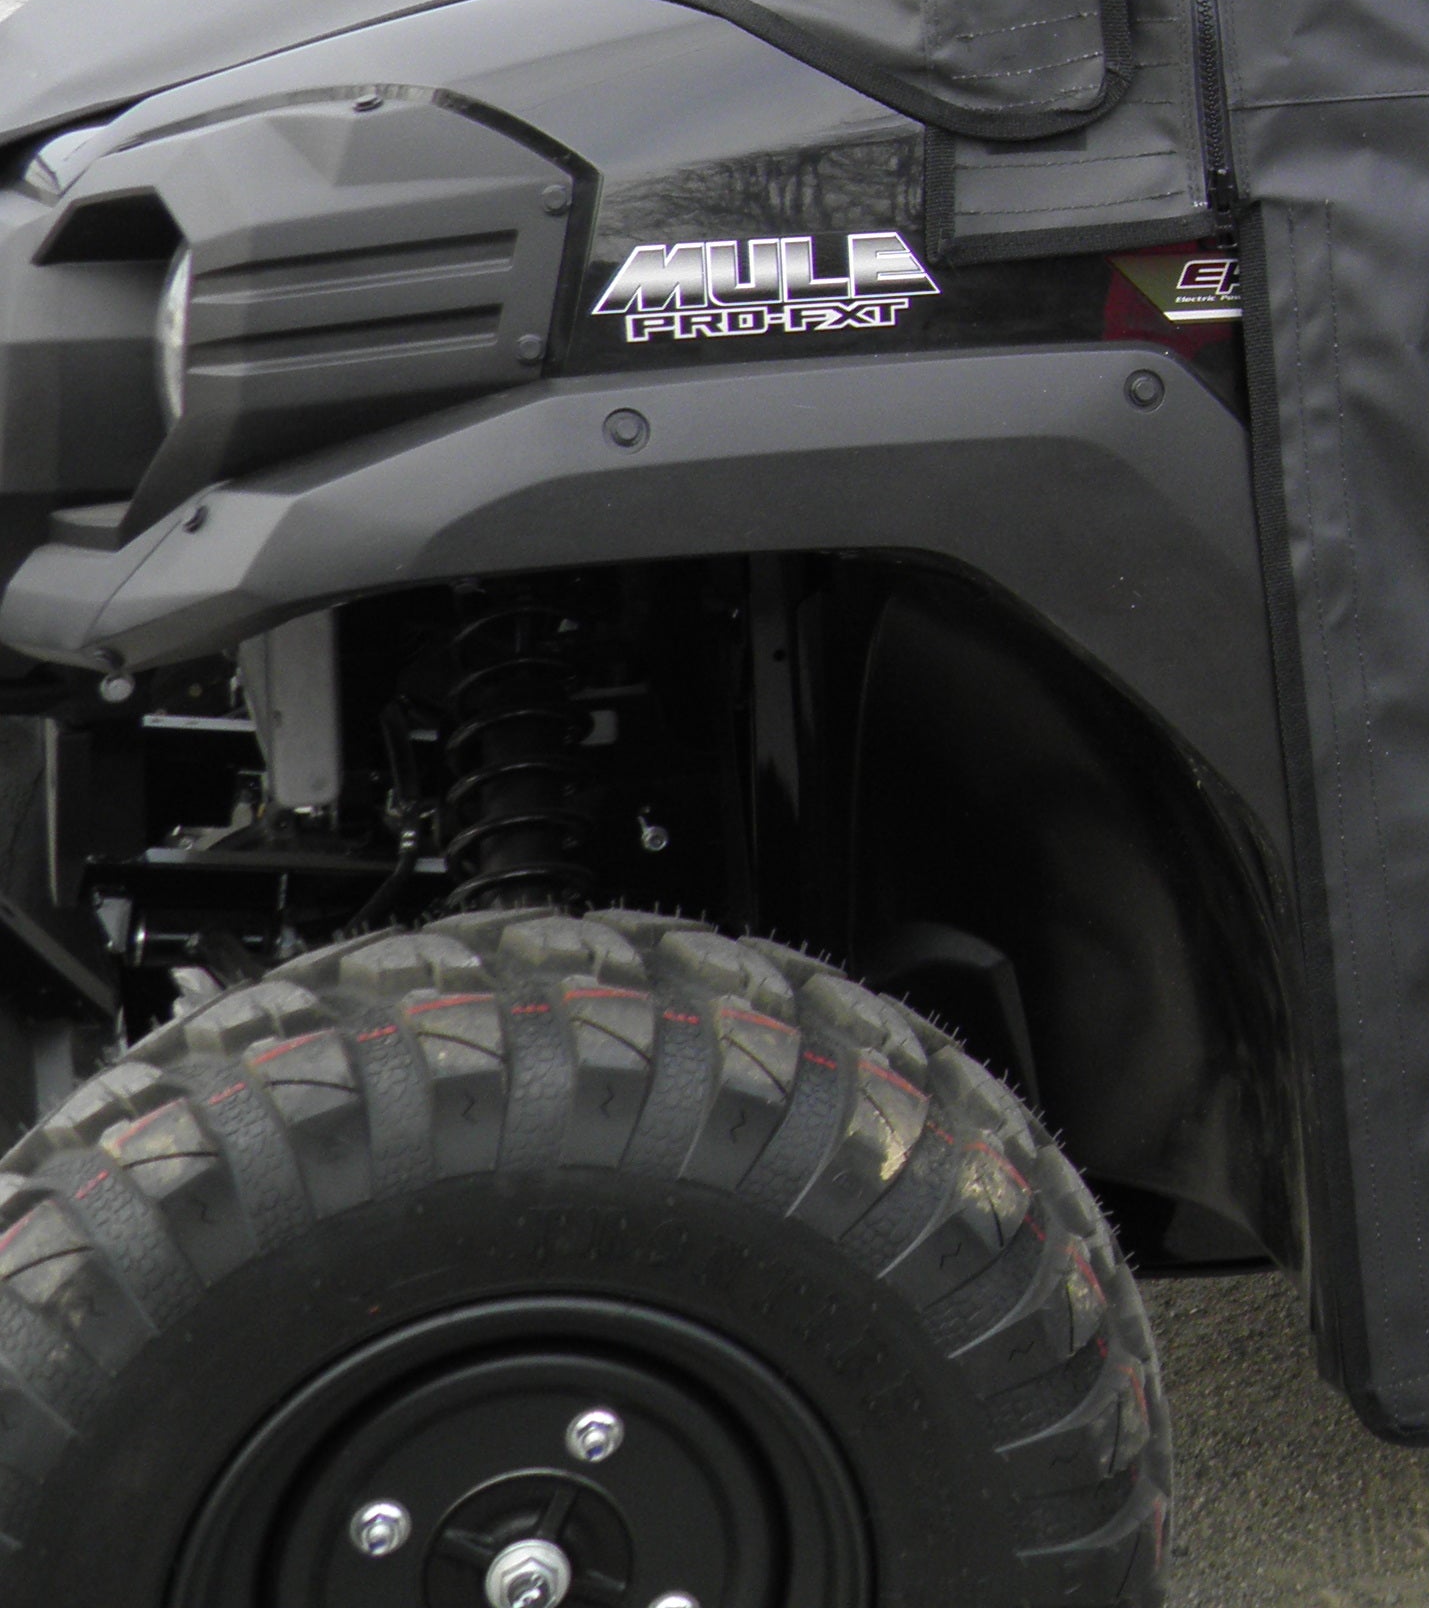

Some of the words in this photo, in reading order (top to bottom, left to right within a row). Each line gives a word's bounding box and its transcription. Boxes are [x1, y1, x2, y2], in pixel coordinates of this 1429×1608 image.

[592, 231, 941, 315] MULE
[1176, 258, 1240, 296] EP
[1175, 294, 1217, 304] Electric
[1220, 294, 1241, 302] Pow
[625, 298, 909, 344] PRO-FXT
